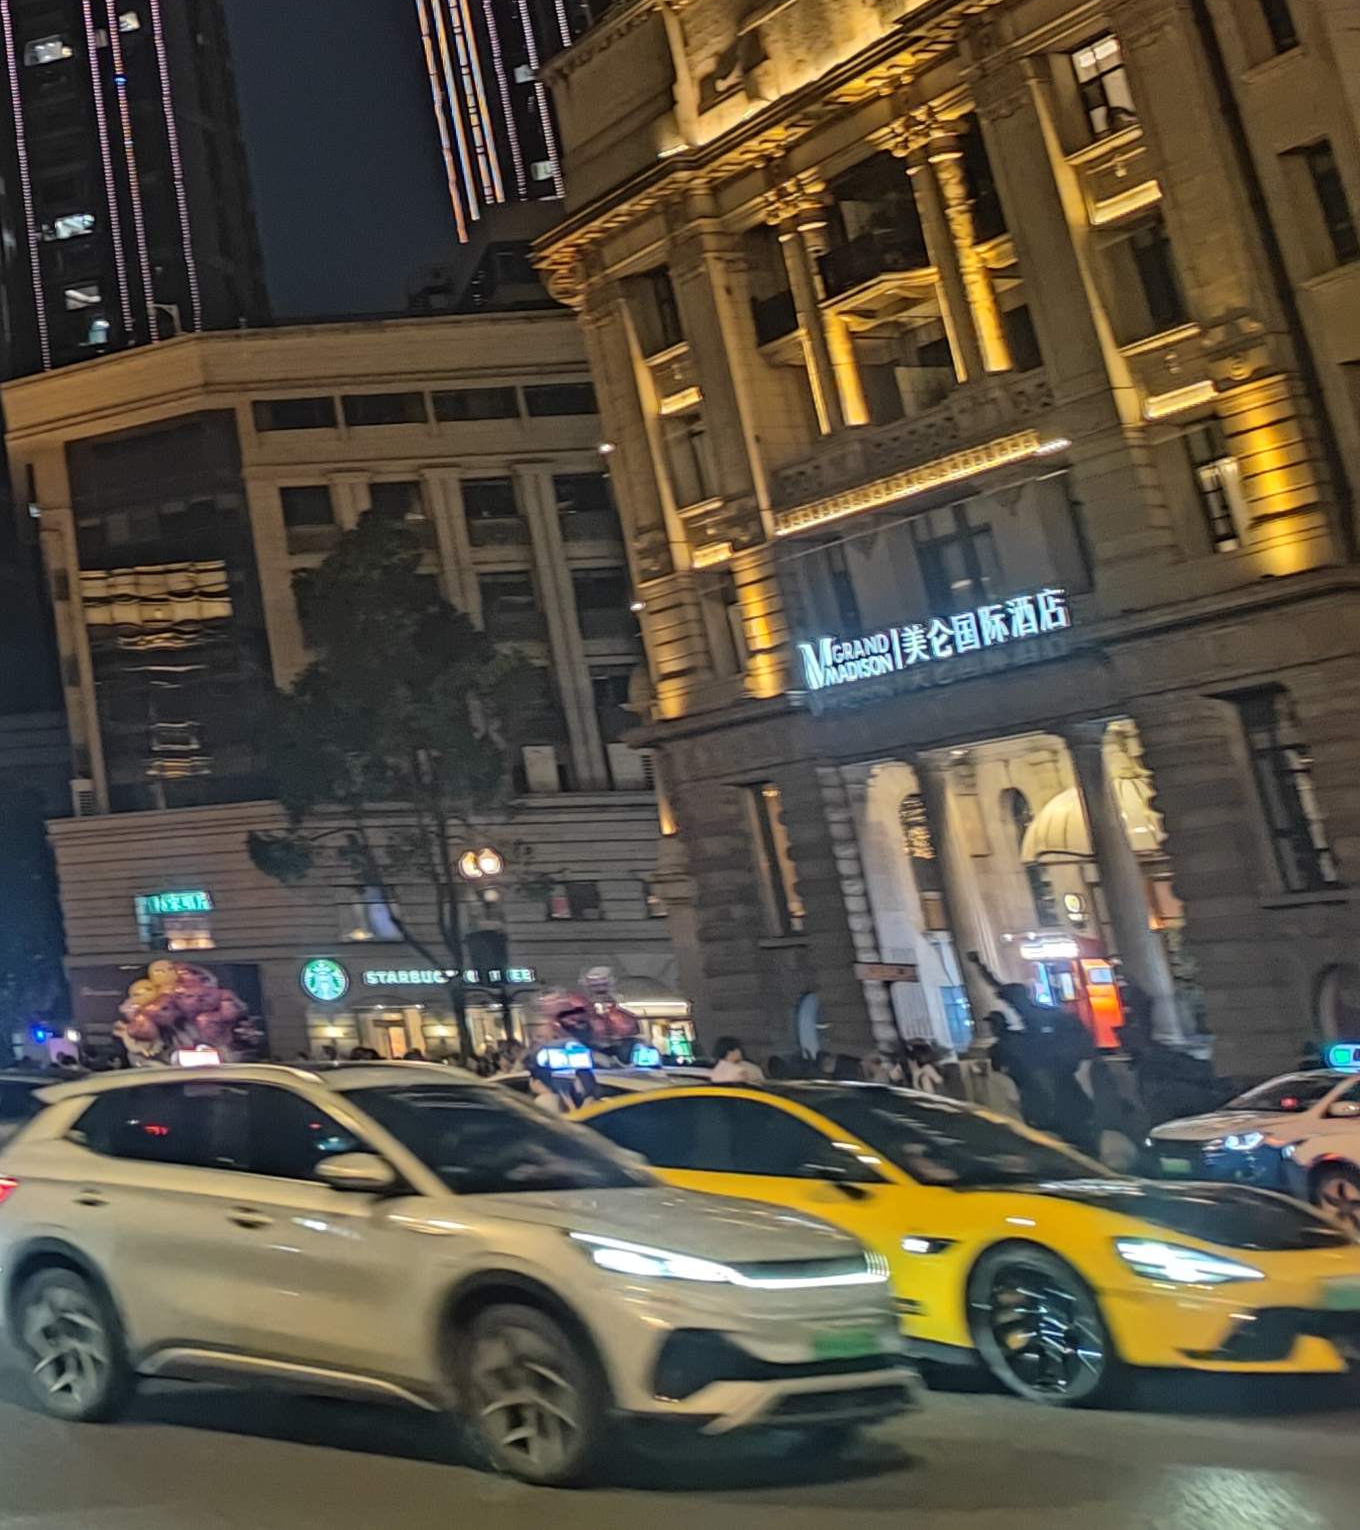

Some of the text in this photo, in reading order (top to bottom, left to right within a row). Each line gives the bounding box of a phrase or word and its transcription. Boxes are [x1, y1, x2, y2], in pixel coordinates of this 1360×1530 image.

[899, 588, 1070, 665] 美仑国际酒店
[832, 633, 890, 663] GRAND
[825, 652, 894, 686] MADISON
[365, 970, 460, 985] STARBUC
